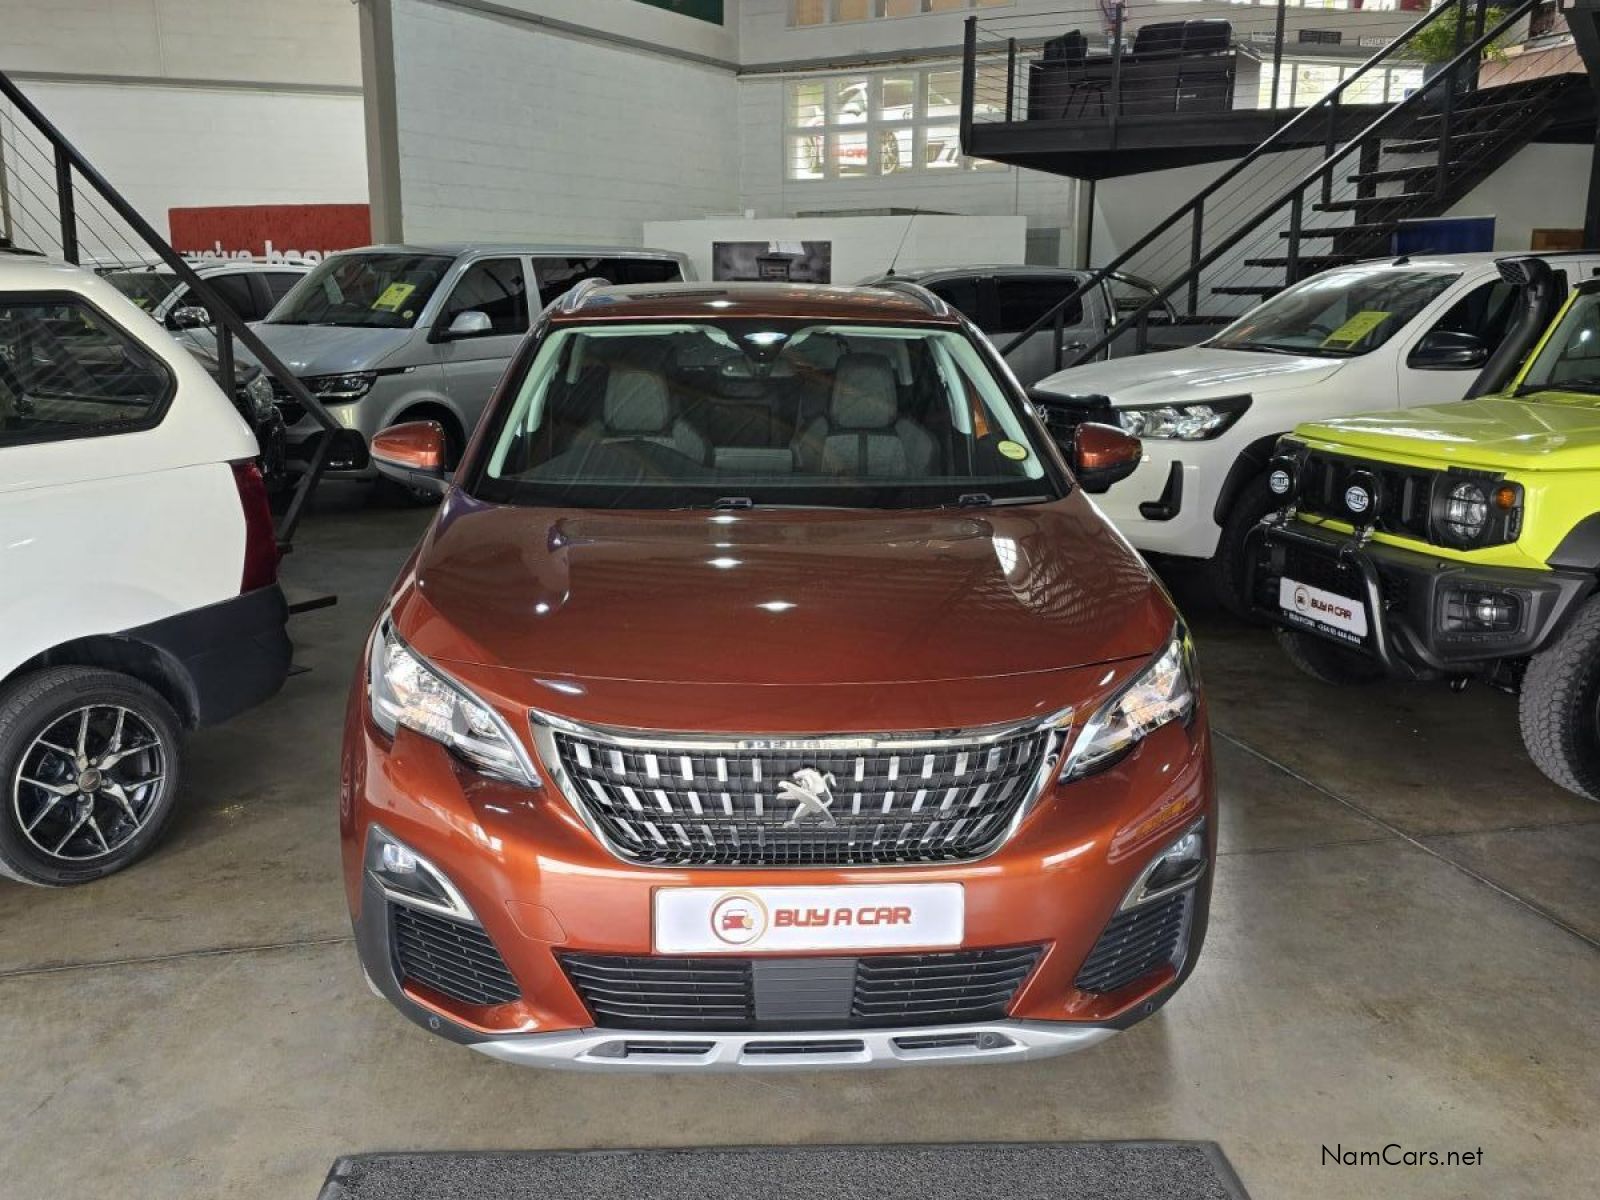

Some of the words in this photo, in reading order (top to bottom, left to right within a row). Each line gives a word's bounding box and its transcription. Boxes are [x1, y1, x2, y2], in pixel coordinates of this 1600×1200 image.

[1311, 598, 1327, 612] BUY
[1327, 604, 1334, 614] A
[1335, 606, 1353, 621] CAR
[774, 907, 829, 928] BUY
[833, 907, 850, 926] A
[856, 907, 911, 926] CAR
